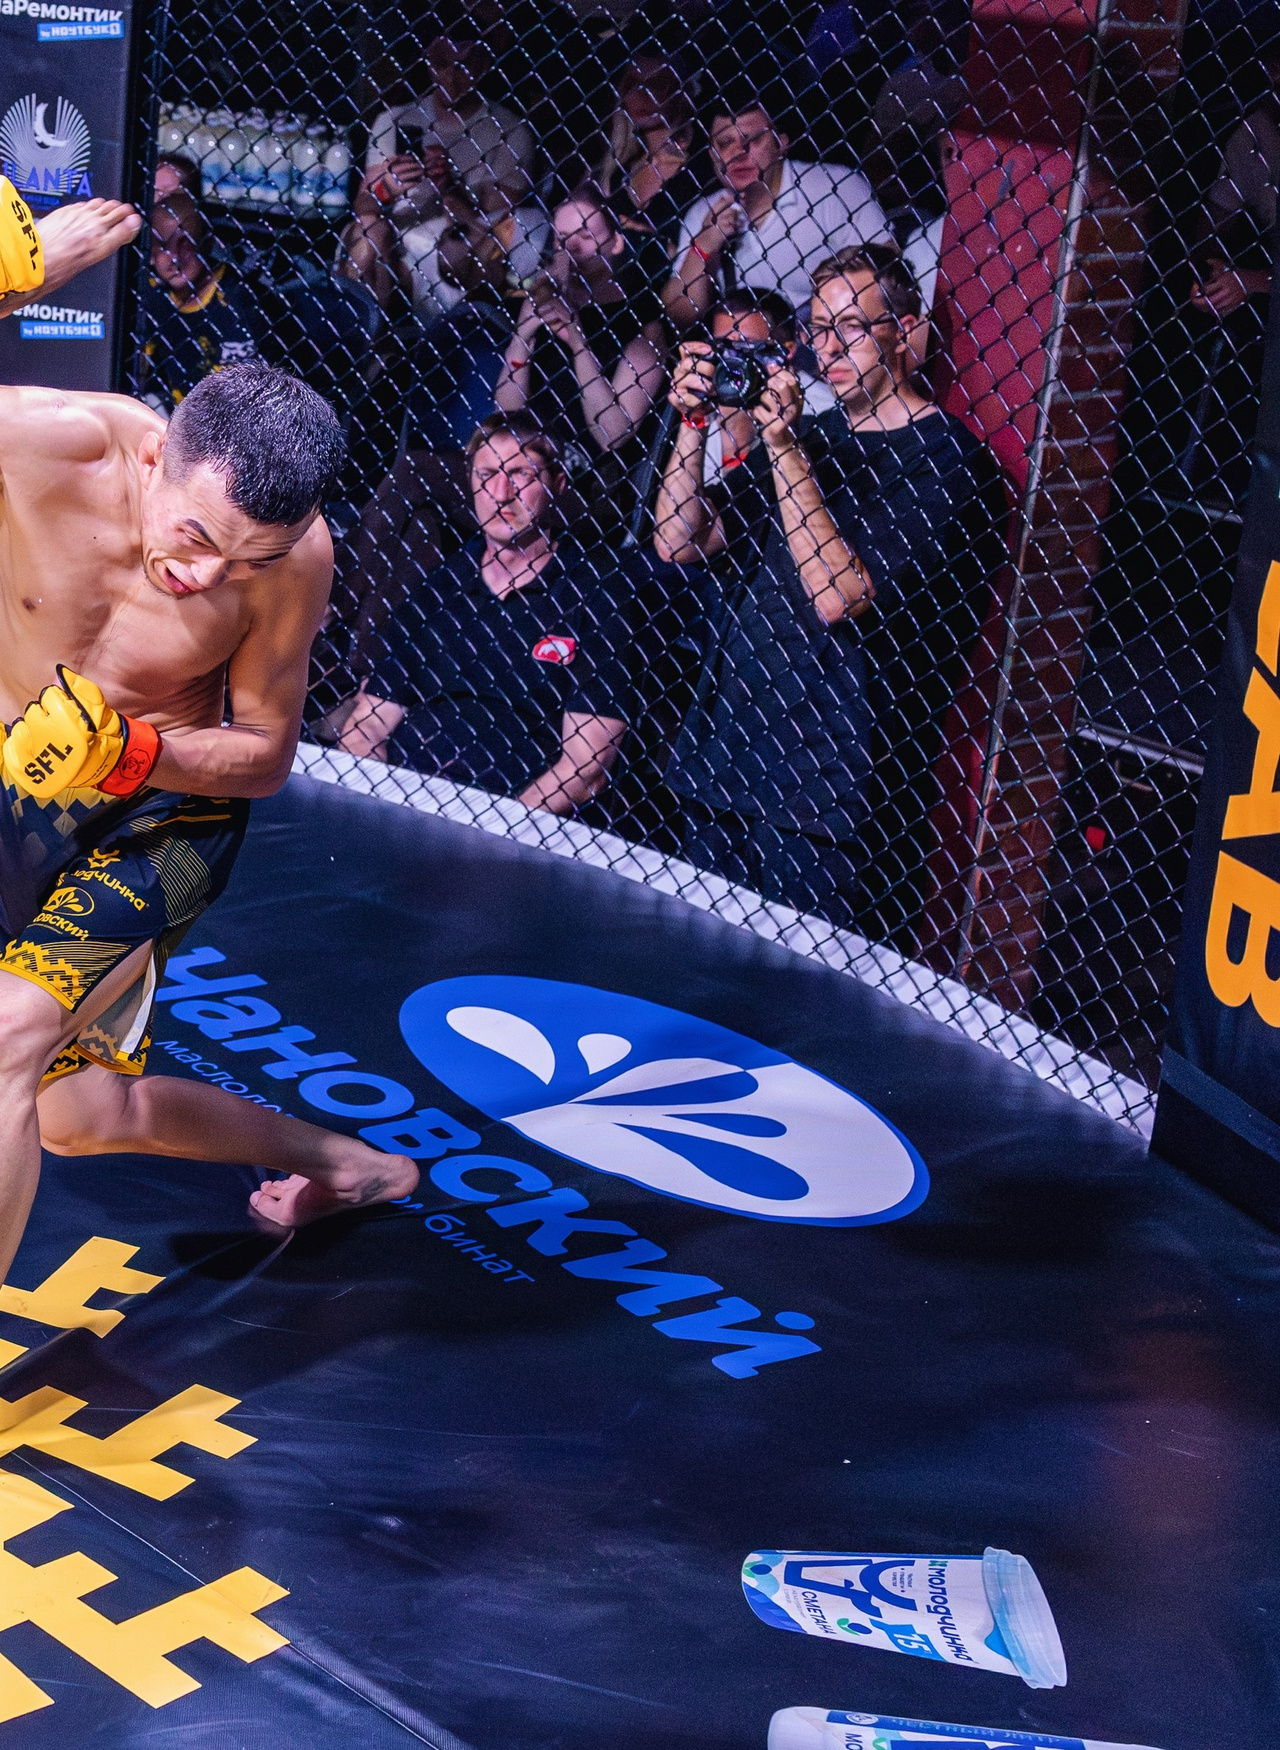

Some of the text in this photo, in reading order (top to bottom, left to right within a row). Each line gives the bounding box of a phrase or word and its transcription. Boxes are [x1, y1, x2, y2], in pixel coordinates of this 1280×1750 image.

[11, 200, 39, 271] SFL
[24, 742, 74, 785] SFL
[155, 946, 822, 1380] Чановский
